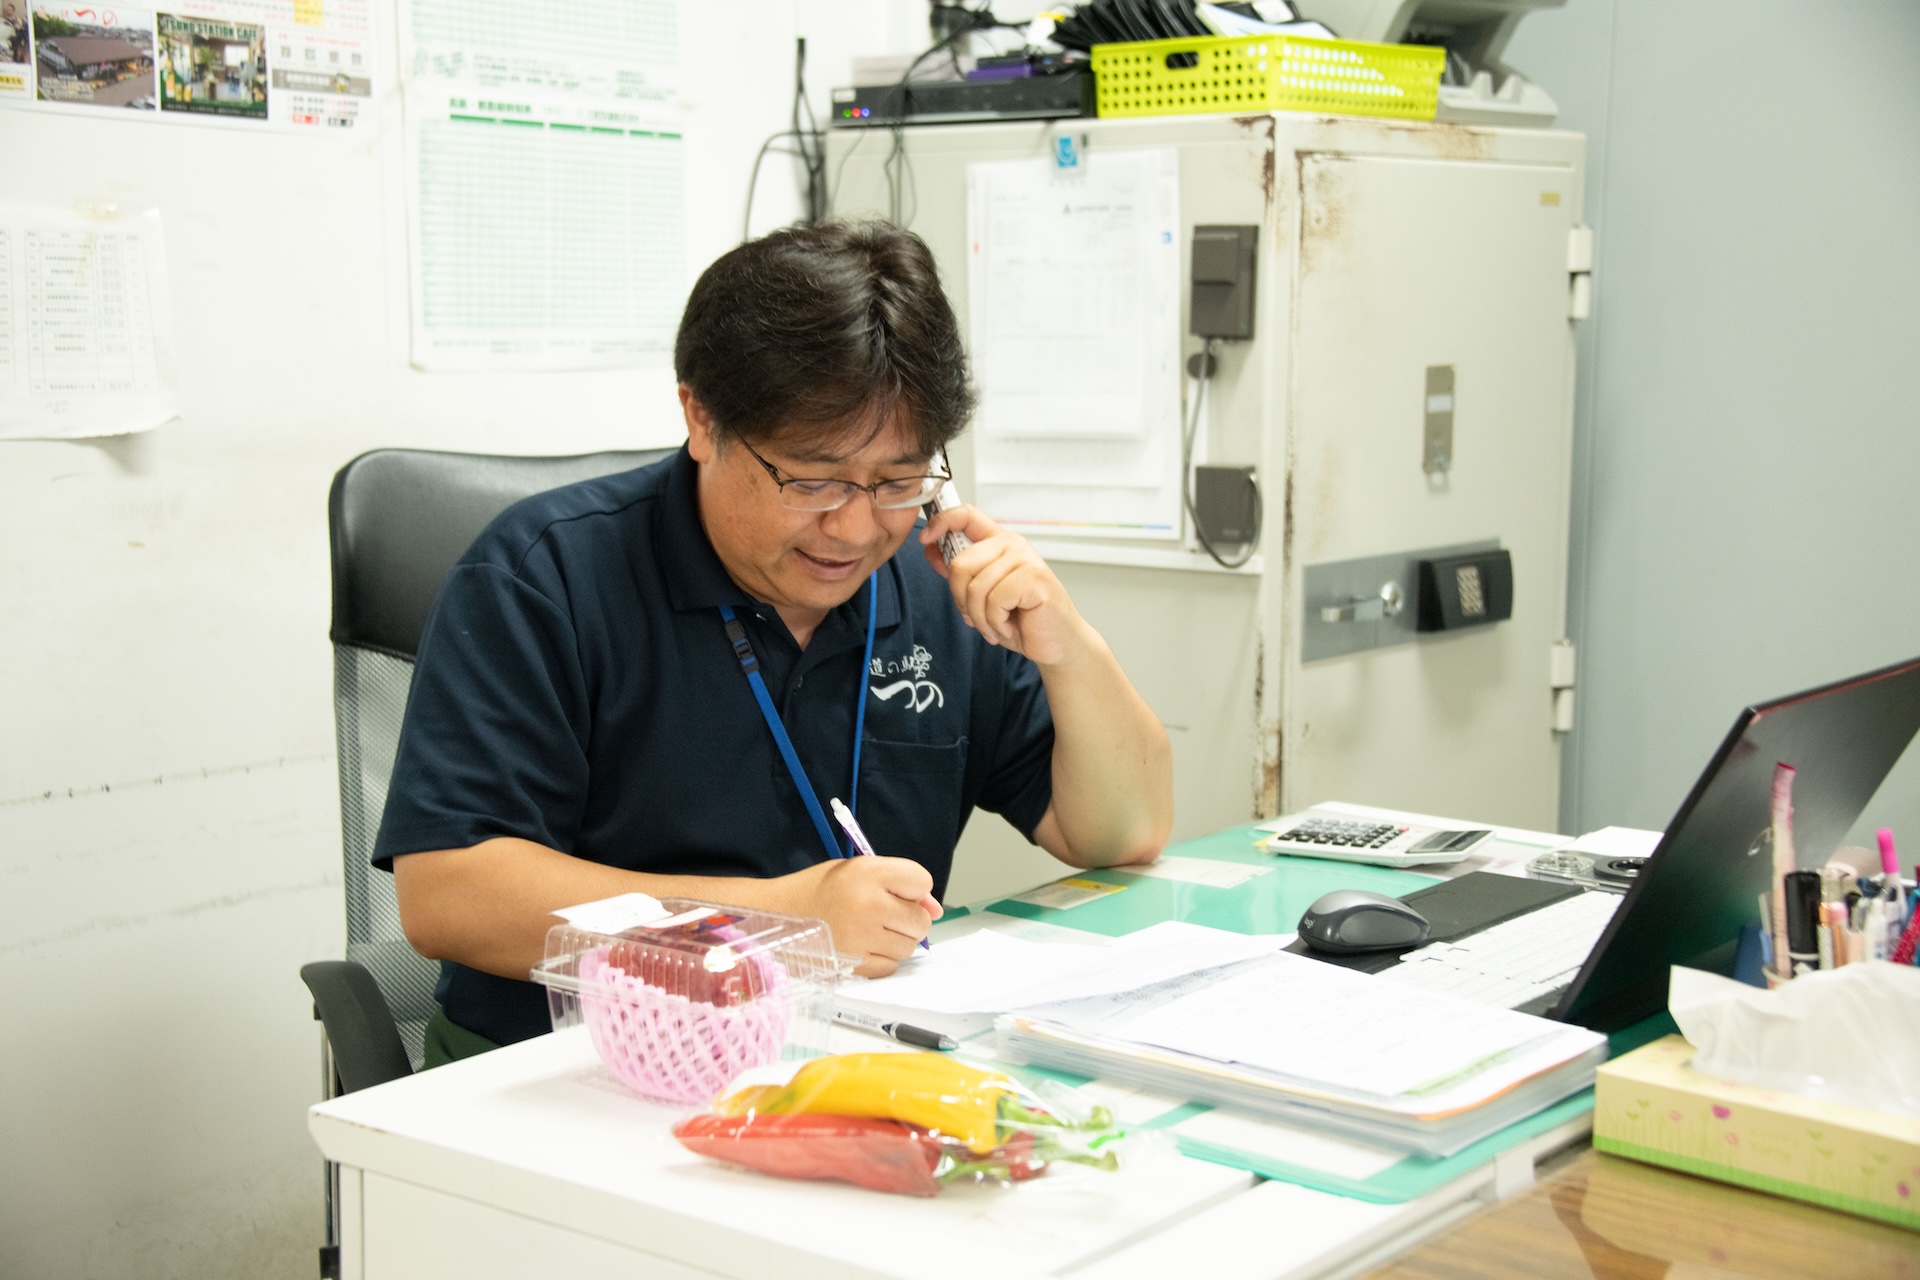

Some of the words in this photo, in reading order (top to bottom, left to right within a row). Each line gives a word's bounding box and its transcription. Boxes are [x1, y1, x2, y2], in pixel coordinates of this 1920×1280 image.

[165, 18, 195, 33] TSUNO
[197, 22, 234, 37] STATION
[870, 680, 944, 713] つの
[1304, 917, 1316, 929] logi
